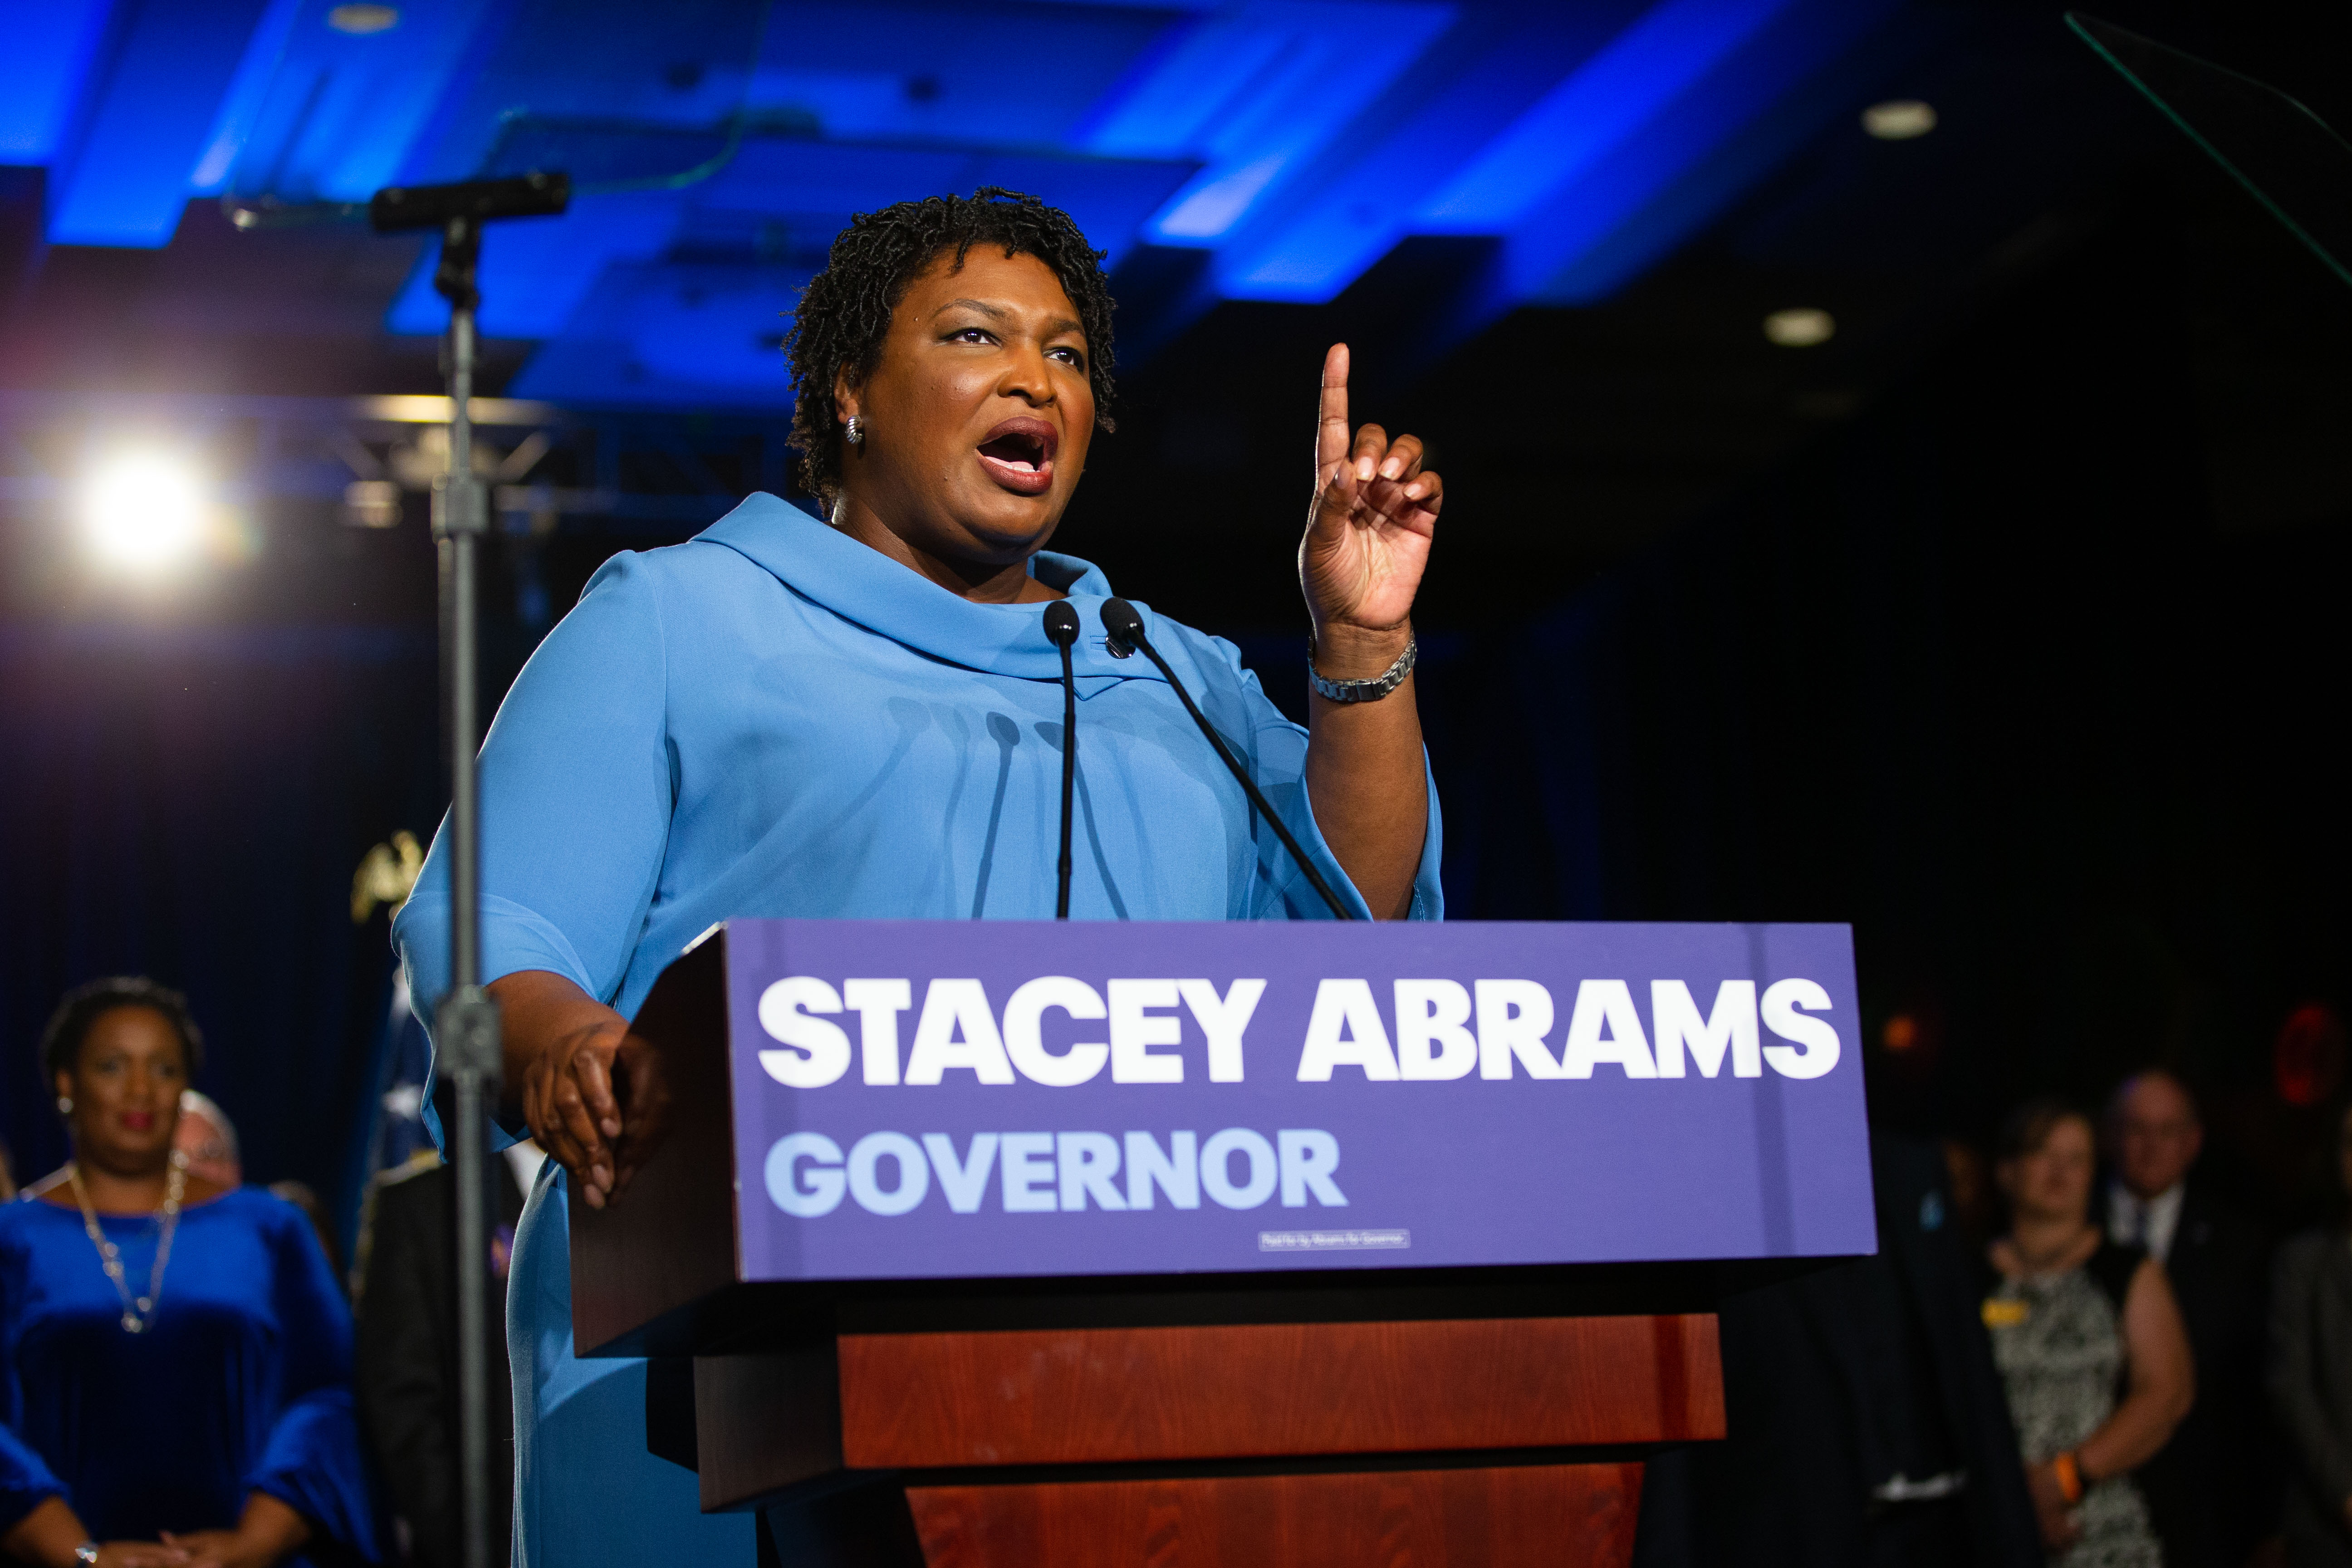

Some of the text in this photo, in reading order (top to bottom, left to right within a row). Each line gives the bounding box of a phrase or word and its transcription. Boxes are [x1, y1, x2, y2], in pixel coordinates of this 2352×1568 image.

[758, 975, 1841, 1088] STACEY ABRAMS
[764, 1127, 1349, 1218] GOVERNOR
